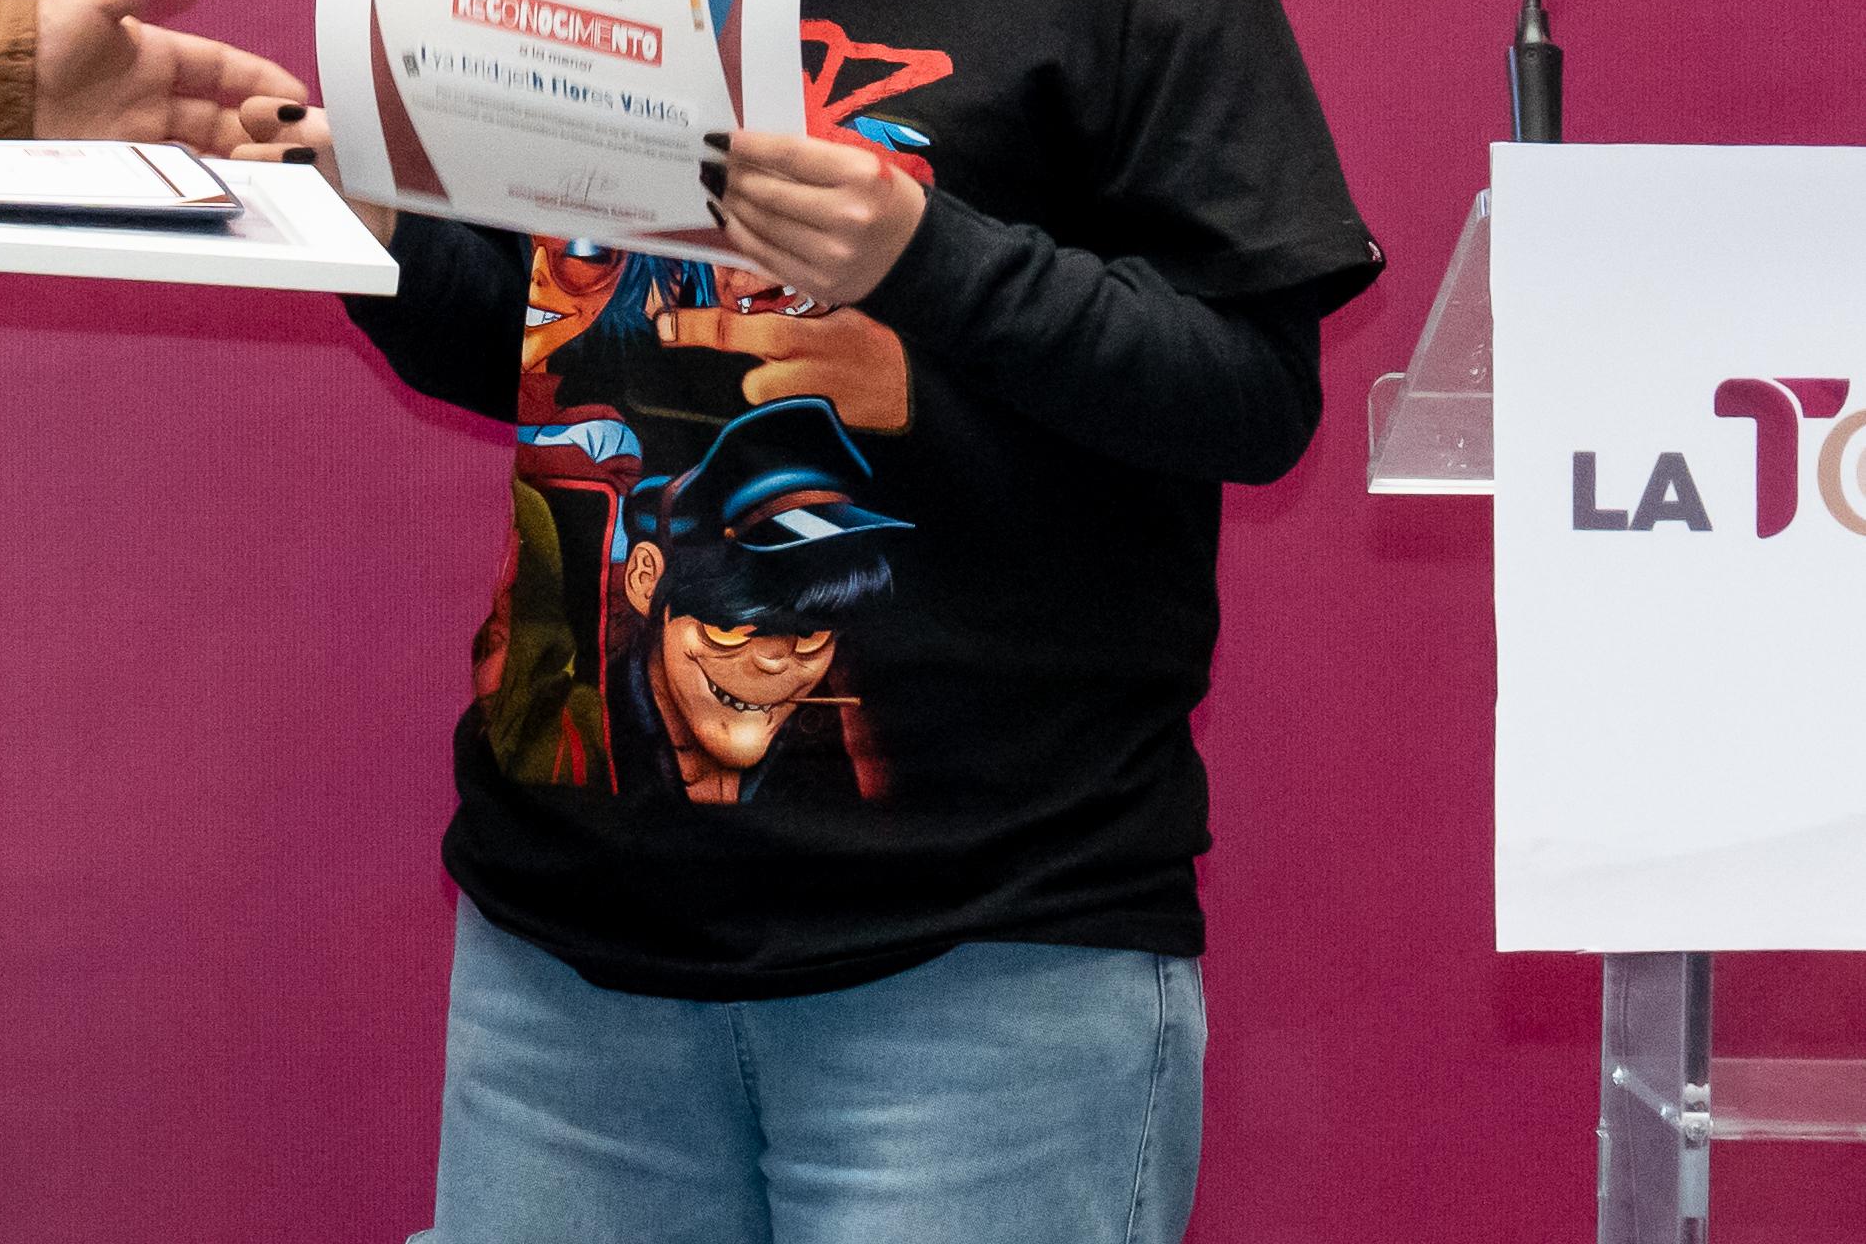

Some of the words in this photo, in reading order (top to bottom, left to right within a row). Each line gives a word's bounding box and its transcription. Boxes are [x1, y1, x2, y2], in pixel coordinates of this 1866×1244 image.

[548, 51, 594, 73] menor
[551, 74, 614, 110] Flores
[1572, 450, 1714, 532] LA
